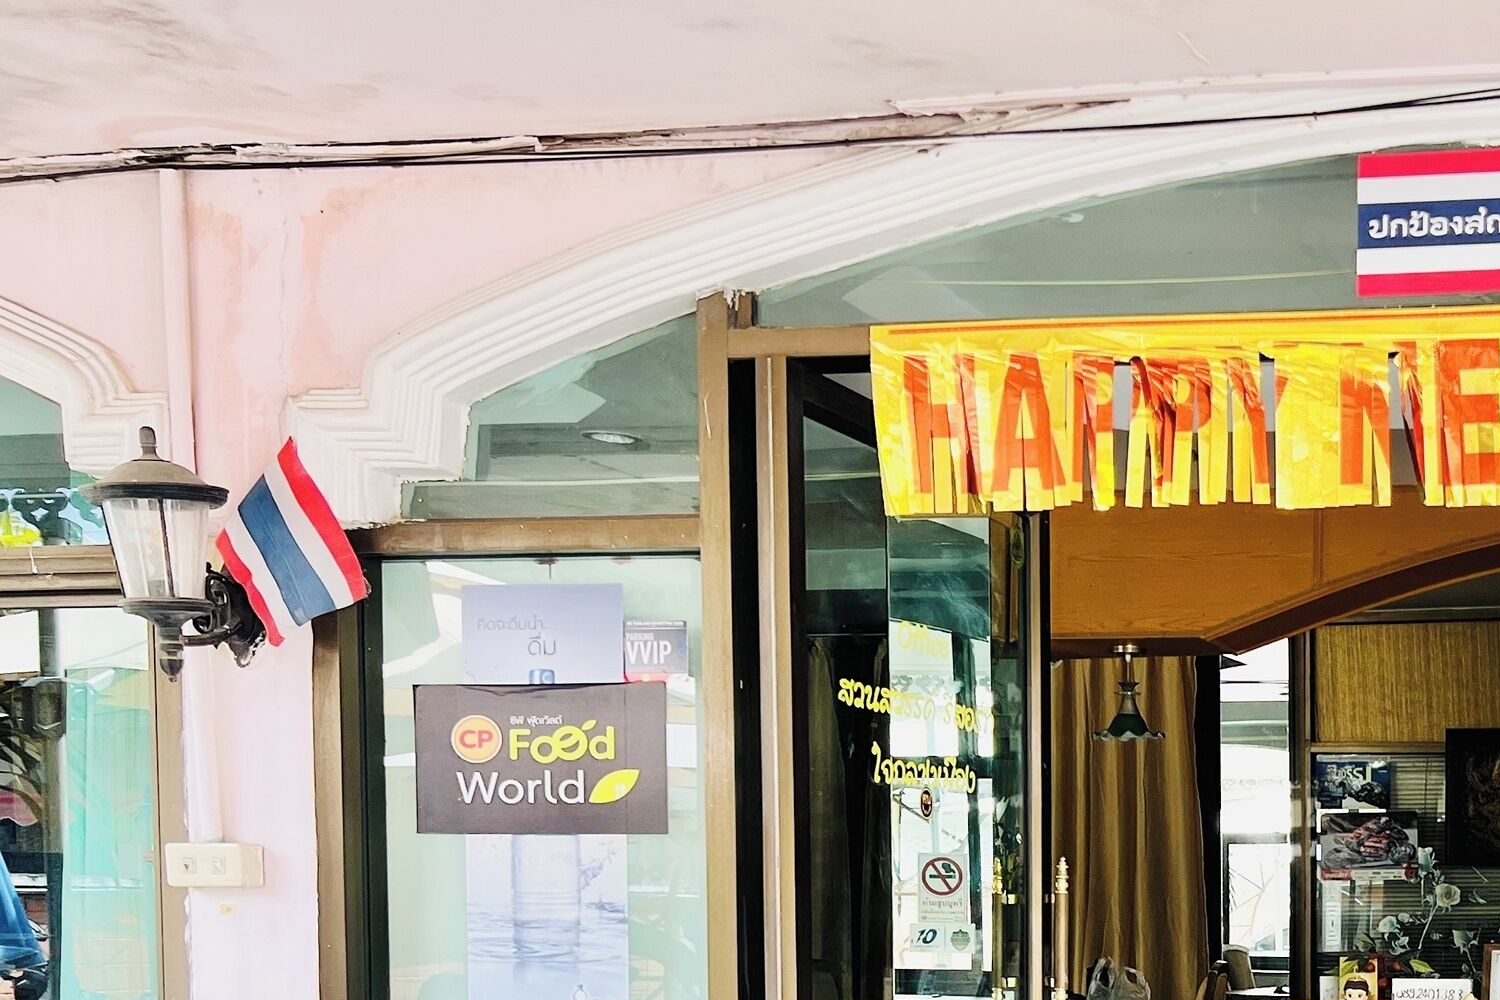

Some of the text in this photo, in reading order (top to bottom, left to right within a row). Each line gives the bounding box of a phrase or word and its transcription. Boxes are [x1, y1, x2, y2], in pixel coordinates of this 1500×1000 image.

[527, 631, 556, 656] ดื่ม
[625, 640, 672, 664] VVIP
[459, 729, 494, 749] CP
[508, 723, 616, 765] Food
[456, 768, 586, 805] World
